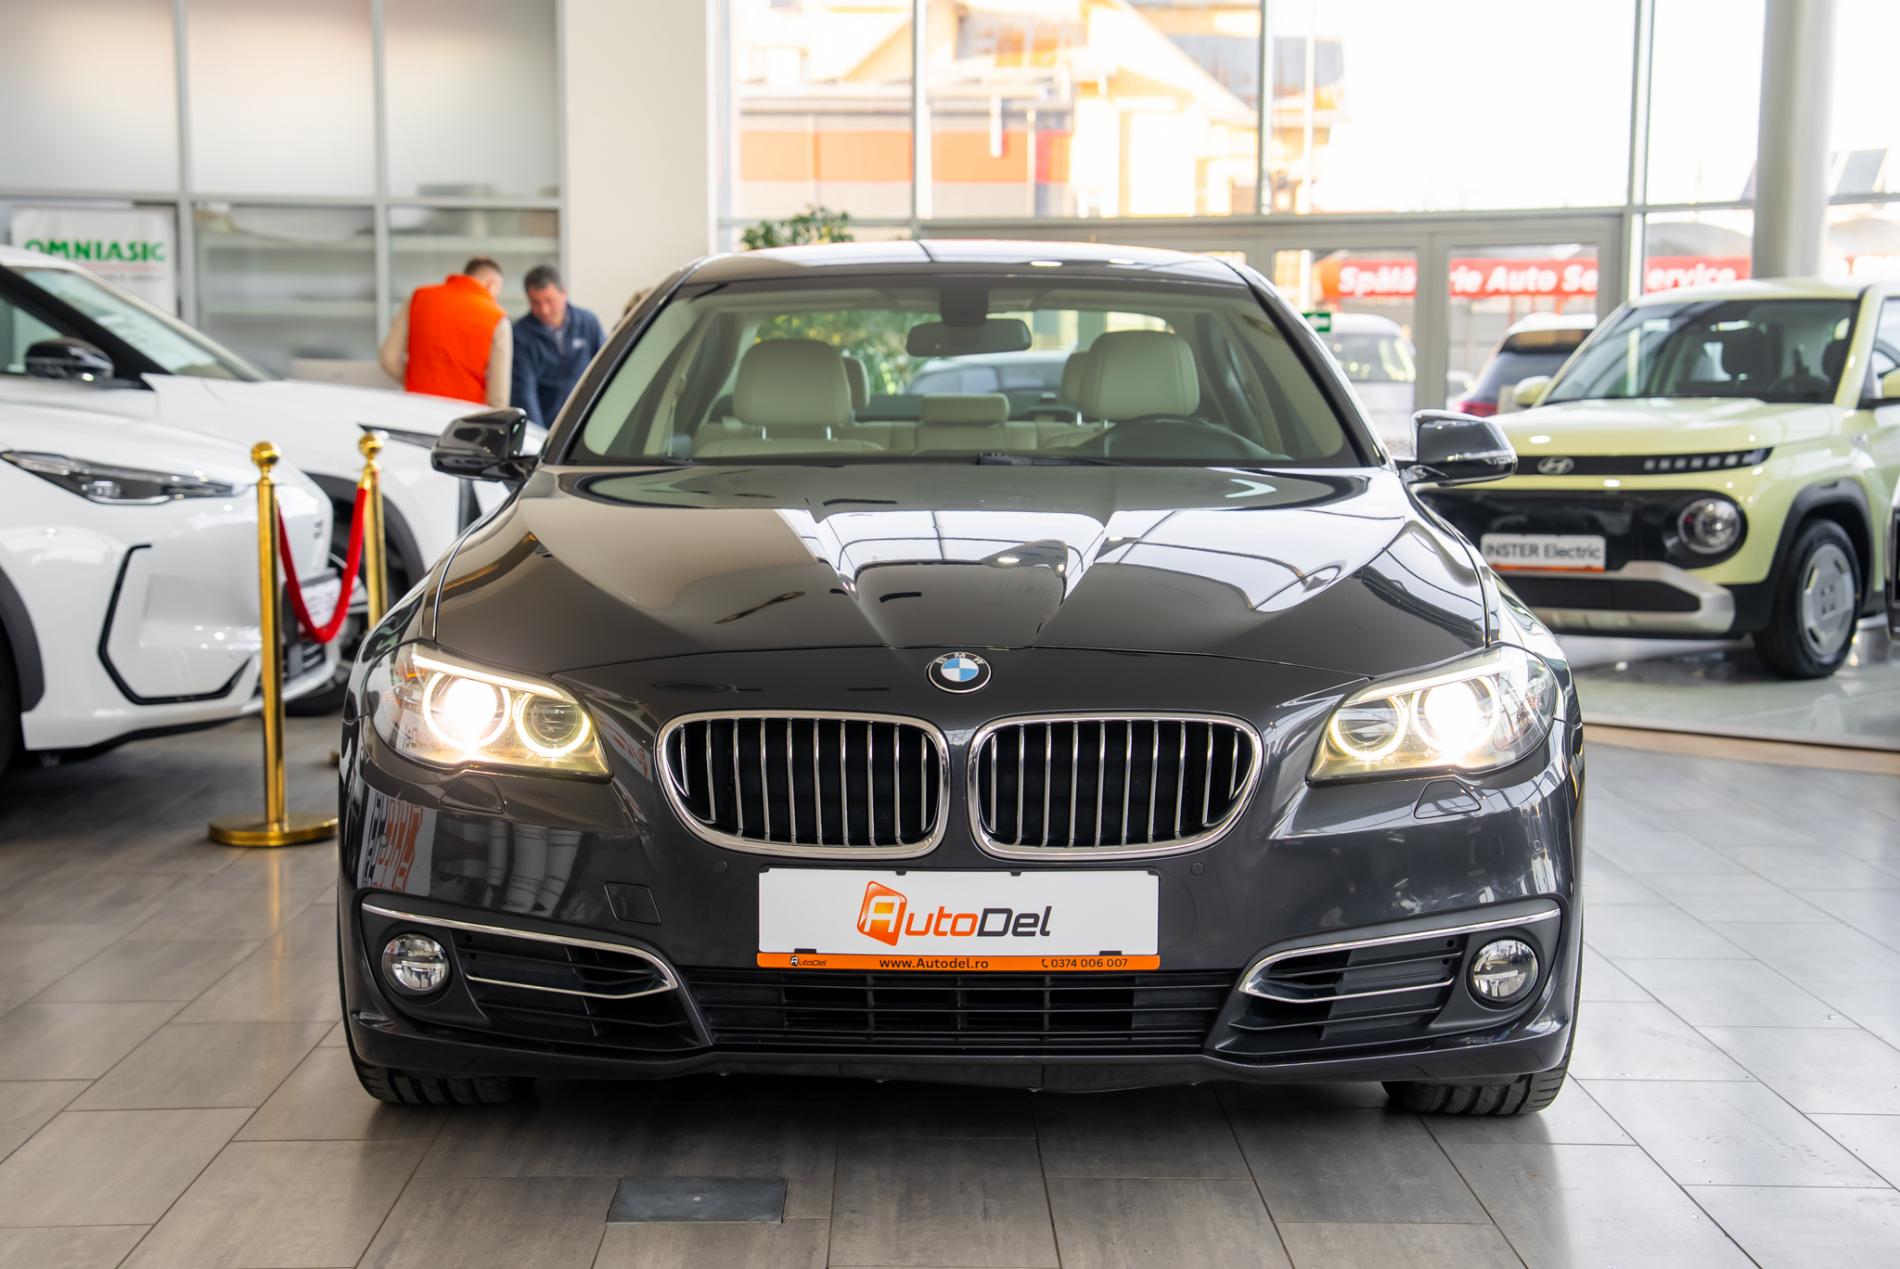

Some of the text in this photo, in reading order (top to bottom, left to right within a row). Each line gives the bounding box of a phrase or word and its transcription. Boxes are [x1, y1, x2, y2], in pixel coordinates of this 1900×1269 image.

[1485, 265, 1558, 292] Auto
[1543, 543, 1601, 560] Electric
[935, 652, 986, 664] BMW
[860, 893, 1053, 938] AutoDel
[790, 955, 827, 967] AutoDel
[879, 957, 989, 969] www.Autodel.ro
[1050, 958, 1128, 968] 0374 006 007
